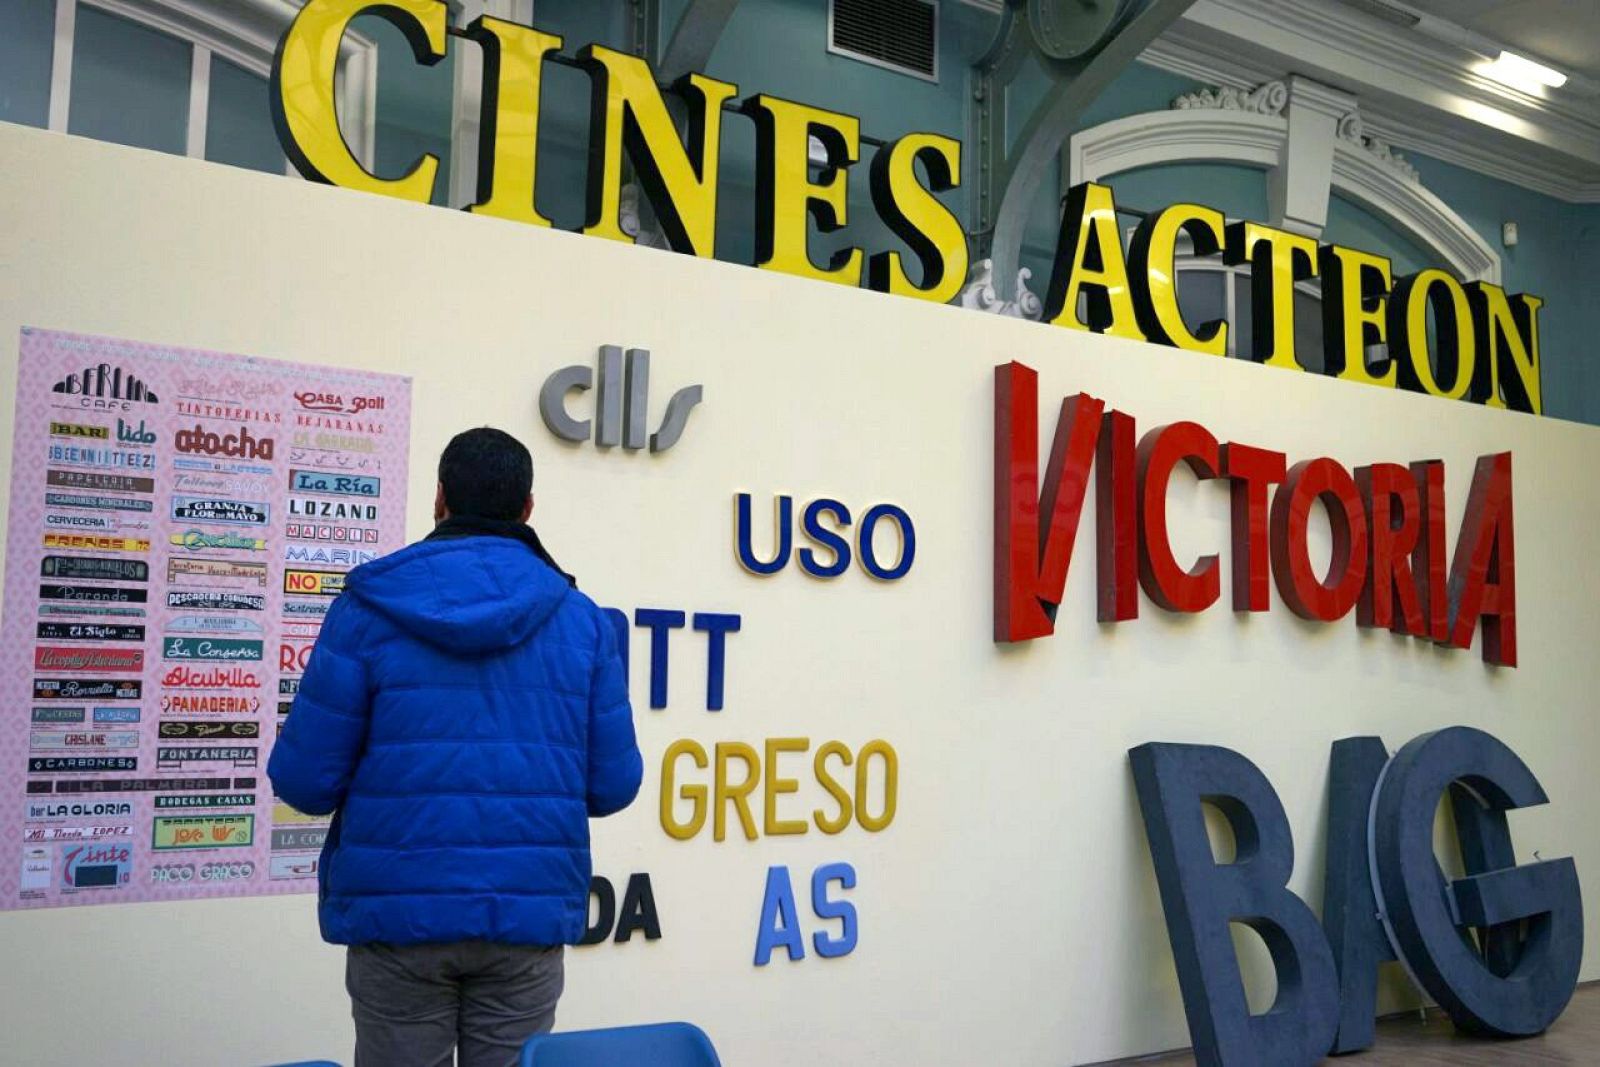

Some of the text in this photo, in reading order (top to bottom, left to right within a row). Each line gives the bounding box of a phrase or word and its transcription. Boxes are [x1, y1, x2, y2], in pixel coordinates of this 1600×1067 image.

[270, 0, 1545, 415] CINES ACTEON
[117, 418, 156, 444] lido
[175, 424, 274, 460] atocha
[298, 475, 328, 490] La
[194, 502, 246, 512] GRANJA
[289, 500, 377, 520] LOZANO
[994, 358, 1517, 670] VICTORIA
[46, 515, 106, 526] CERVECERIA
[286, 524, 379, 543] MACOIN
[732, 492, 916, 581] USO
[289, 573, 317, 590] NO
[600, 608, 741, 711] TT
[172, 696, 249, 713] PANADERIA
[45, 758, 126, 769] CARBONES
[659, 738, 899, 842] GRESO
[47, 804, 69, 816] LA
[71, 803, 132, 816] GLORIA
[160, 796, 252, 806] BODEGAS CASAS
[1128, 725, 1584, 1067] BAG
[754, 862, 858, 966] AS
